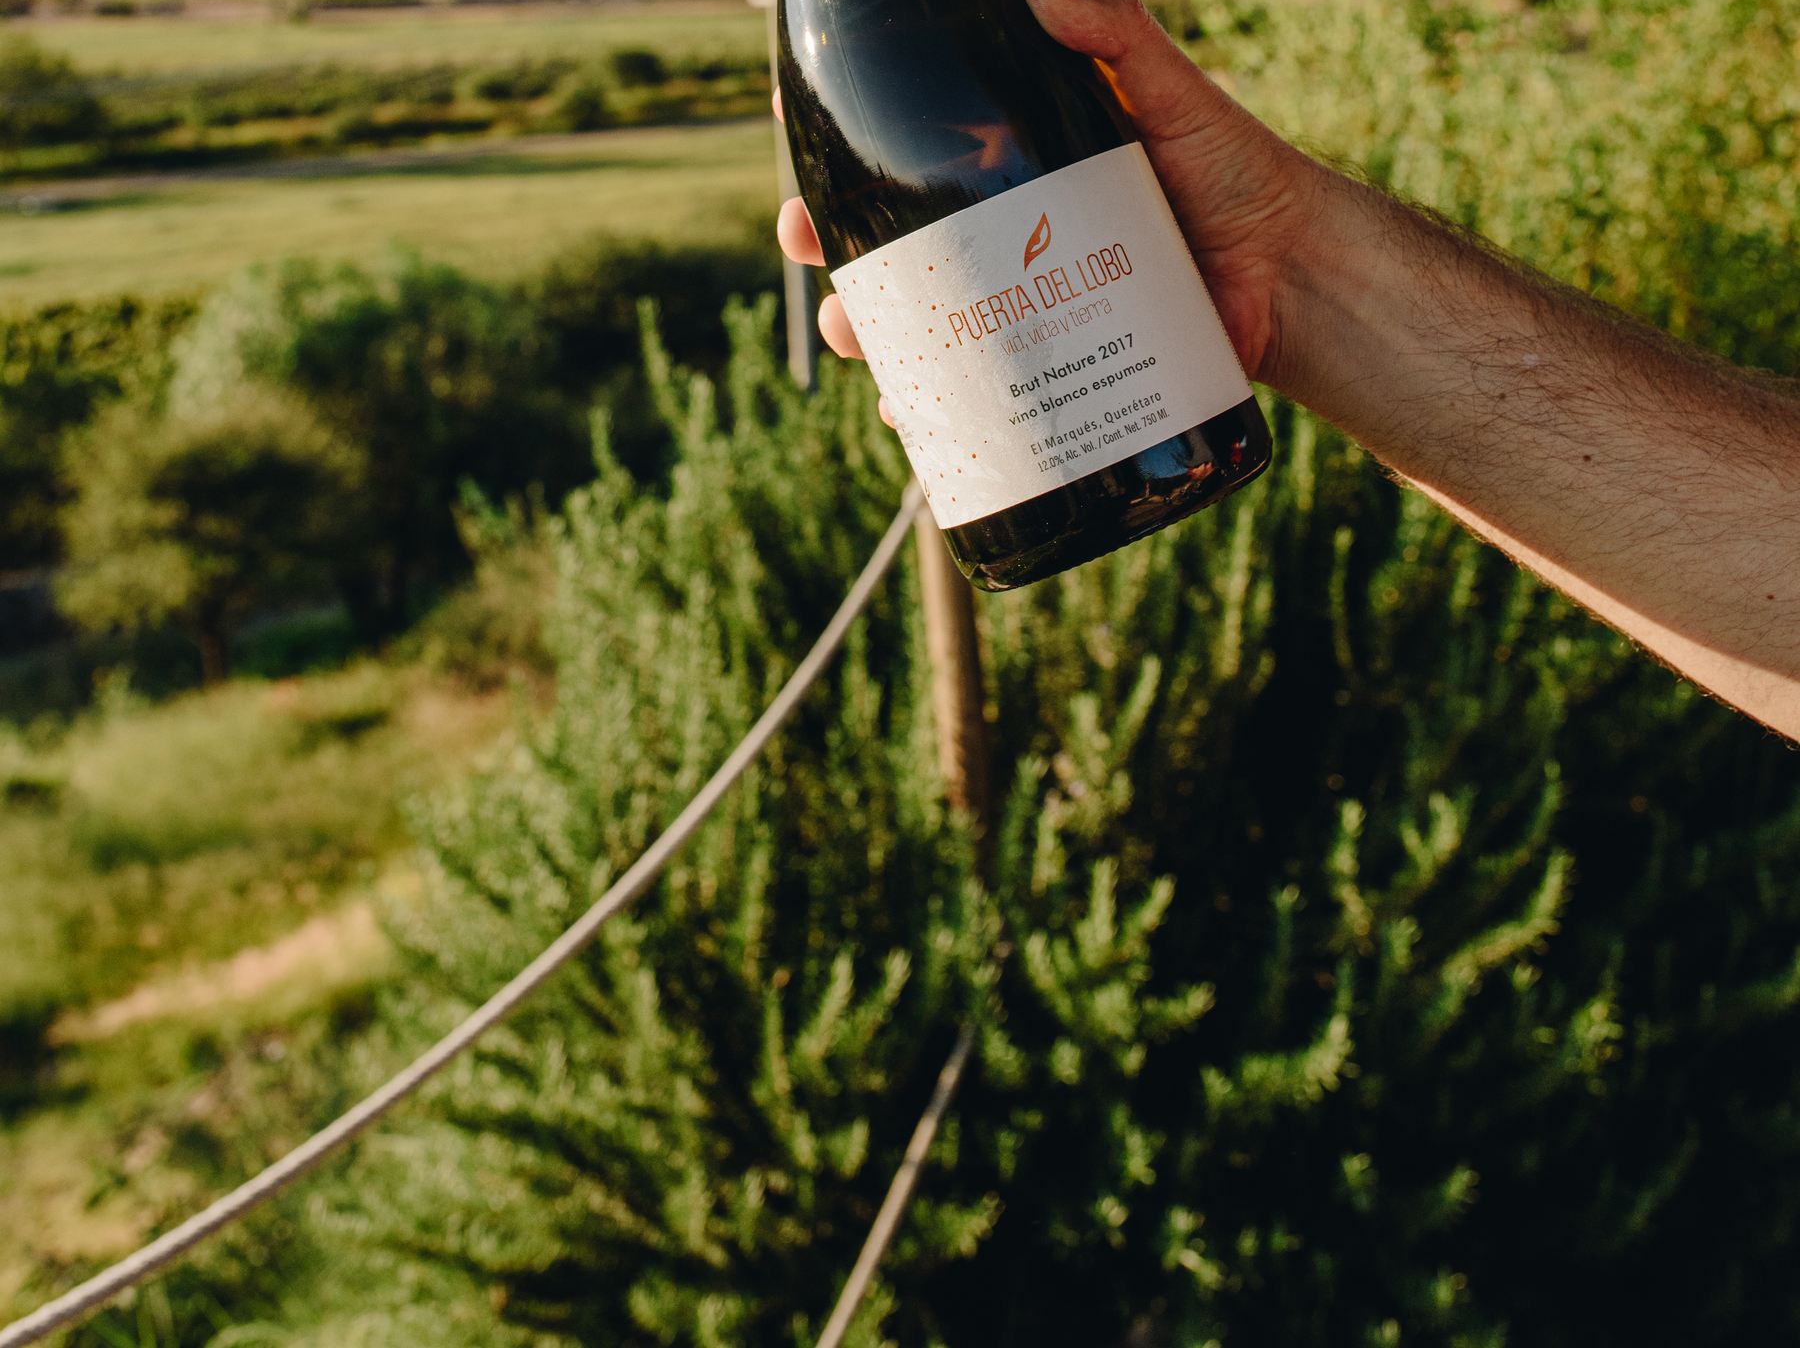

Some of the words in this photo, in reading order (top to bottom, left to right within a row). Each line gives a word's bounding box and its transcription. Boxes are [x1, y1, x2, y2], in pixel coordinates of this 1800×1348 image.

[948, 285, 1038, 346] PUERTA
[1033, 267, 1082, 309] DEL
[1076, 243, 1132, 291] LOBO
[1001, 331, 1030, 356] vid,
[1027, 319, 1060, 345] vida
[1058, 315, 1070, 334] y
[1068, 298, 1113, 328] tierra
[1009, 376, 1041, 398] Brut
[1042, 355, 1096, 384] Nature
[1098, 333, 1134, 360] 2017
[1009, 408, 1038, 425] vino
[1040, 386, 1088, 413] blanco
[1092, 356, 1156, 391] espumoso
[1030, 442, 1043, 455] El
[1045, 418, 1102, 448] Marqués,
[1104, 392, 1162, 424] Querétaro
[1037, 454, 1064, 472] 12.0%
[1064, 449, 1081, 462] Alc.
[1080, 440, 1097, 454] Vol.
[1102, 429, 1125, 445] Cont.
[1124, 421, 1142, 435] Net.
[1141, 413, 1157, 428] 750
